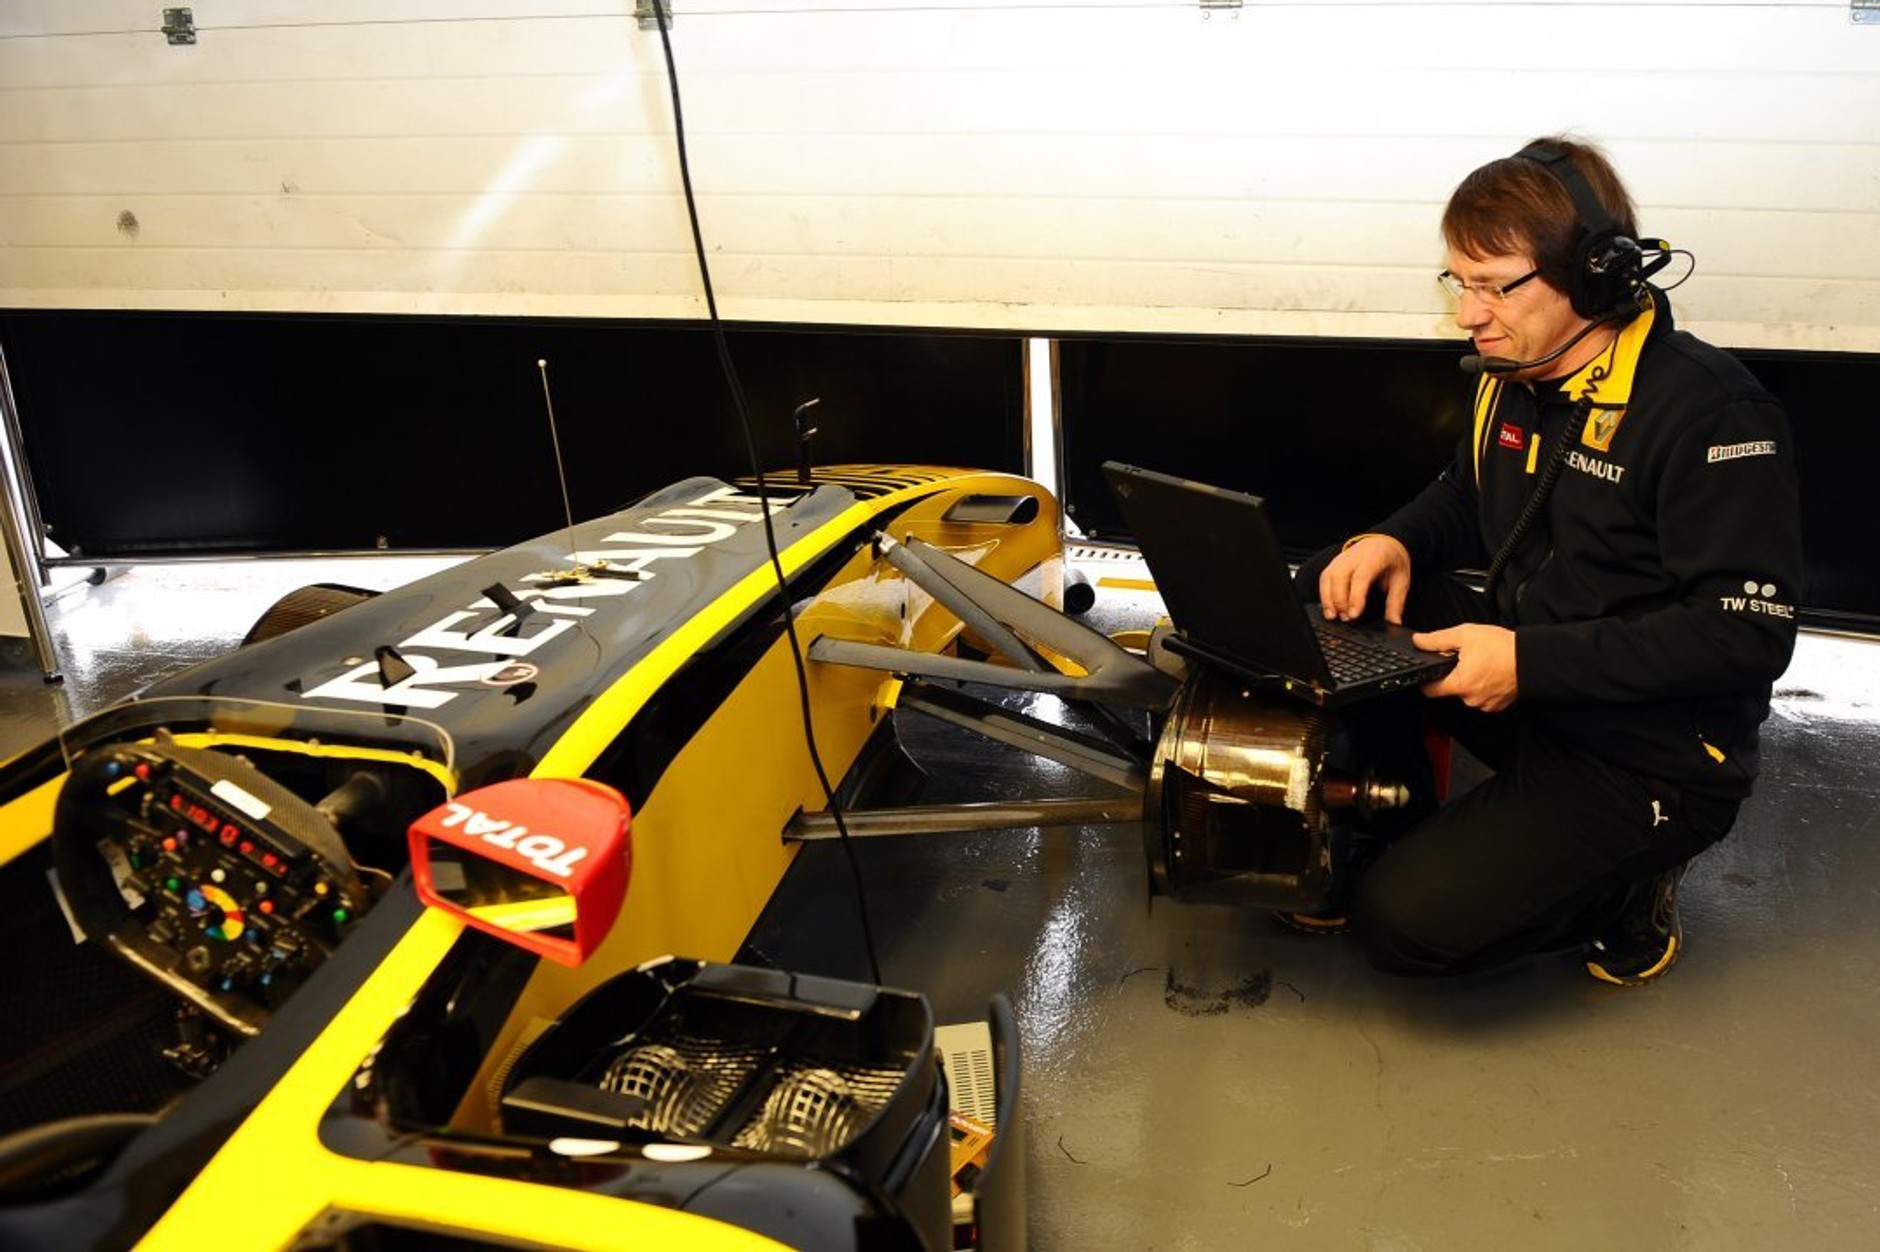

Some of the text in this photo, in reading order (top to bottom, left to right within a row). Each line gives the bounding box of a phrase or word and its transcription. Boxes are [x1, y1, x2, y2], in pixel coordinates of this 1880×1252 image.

[1563, 450, 1625, 483] ENAULT
[1720, 597, 1794, 619] TW STEEL
[441, 802, 588, 877] TOTAL
